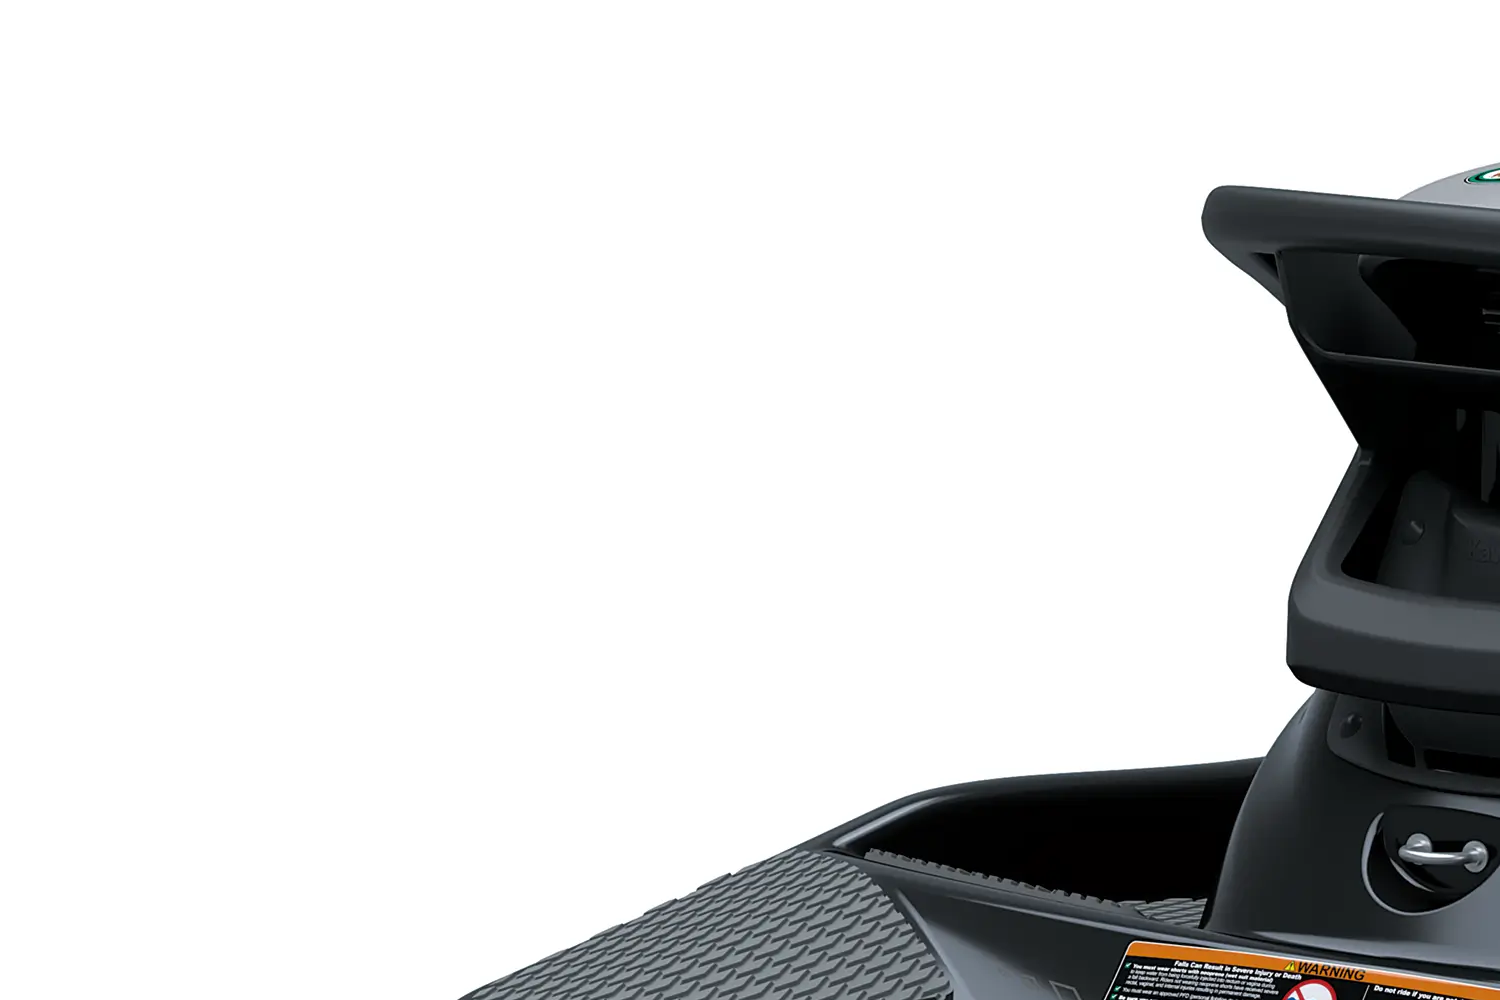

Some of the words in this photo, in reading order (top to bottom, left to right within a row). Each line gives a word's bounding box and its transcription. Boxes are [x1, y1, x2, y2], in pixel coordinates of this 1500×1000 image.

[1297, 960, 1366, 981] WARNING
[1396, 988, 1410, 996] ride
[1417, 992, 1431, 1000] you
